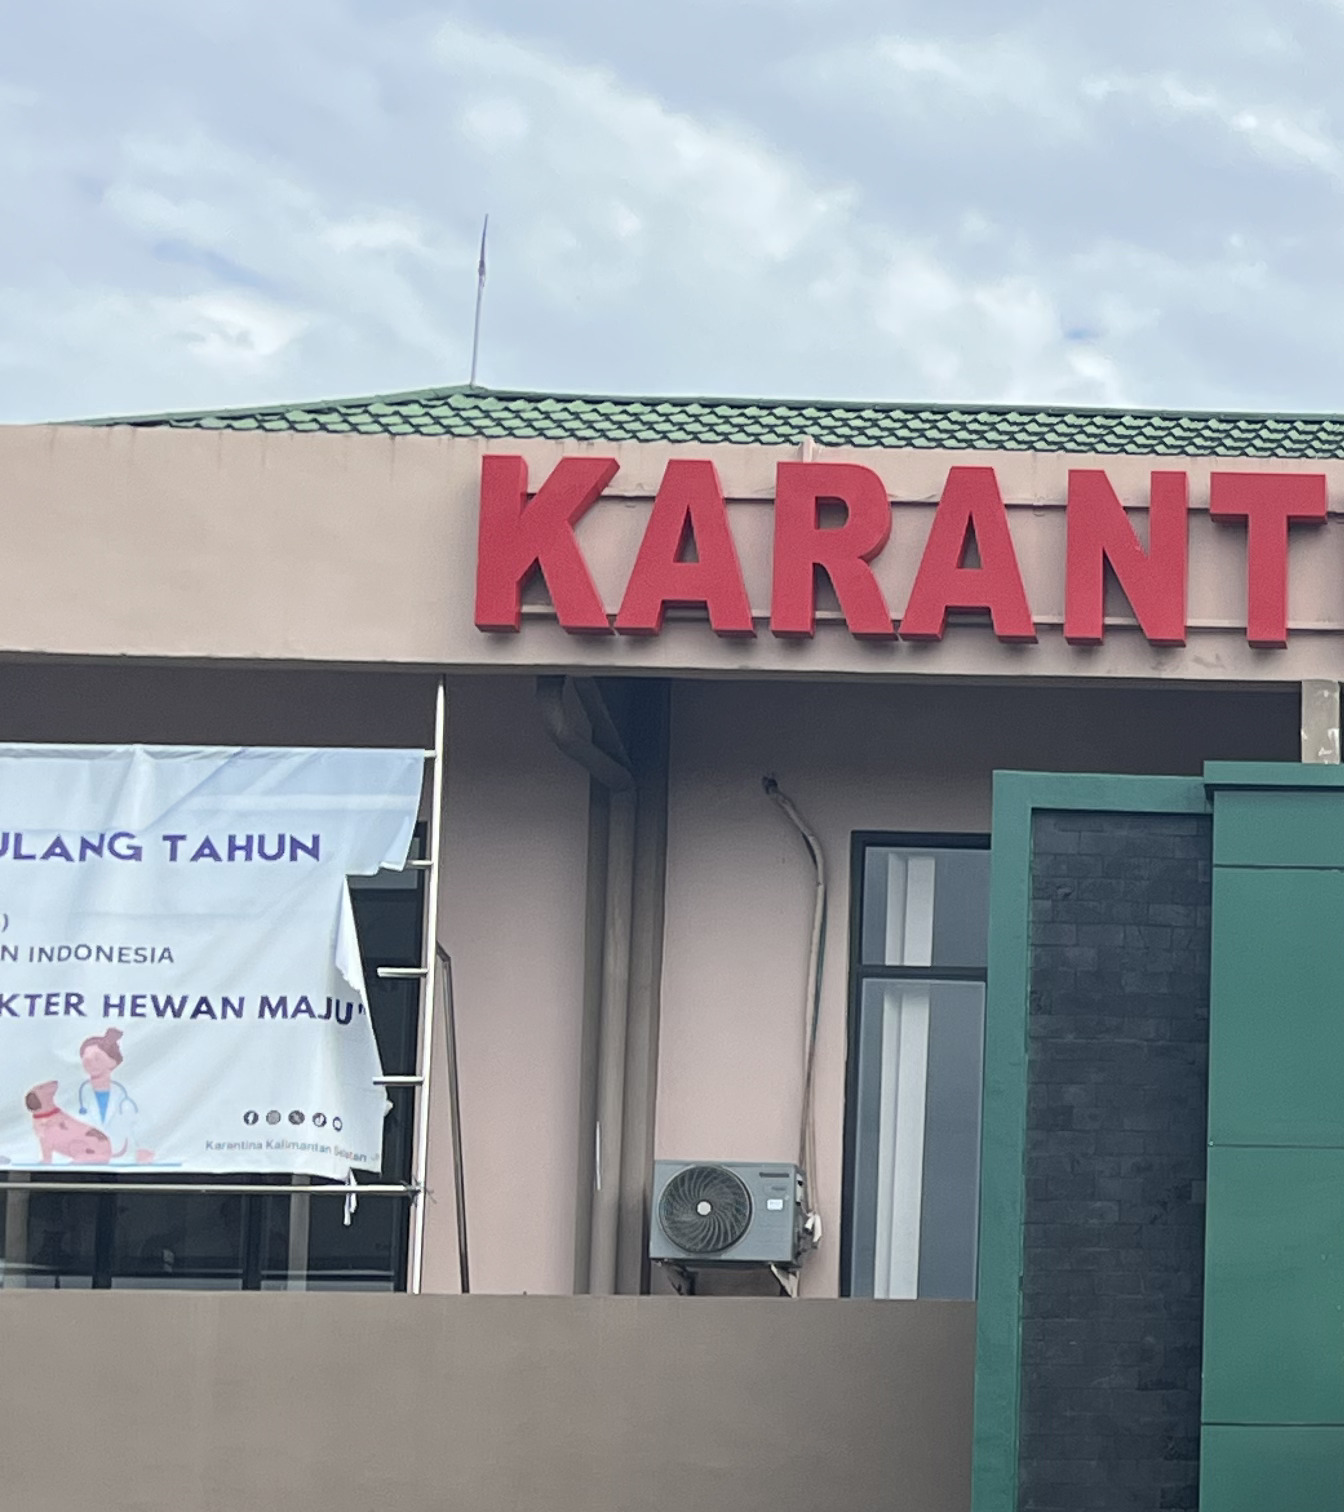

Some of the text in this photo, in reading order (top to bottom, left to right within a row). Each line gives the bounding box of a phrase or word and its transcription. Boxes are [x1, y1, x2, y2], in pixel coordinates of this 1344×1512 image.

[163, 834, 320, 862] TAHUN
[29, 944, 174, 964] INDONESIA
[102, 994, 245, 1019] HEWAN
[205, 1140, 263, 1151] Karantina
[265, 1140, 332, 1155] Kalimantan
